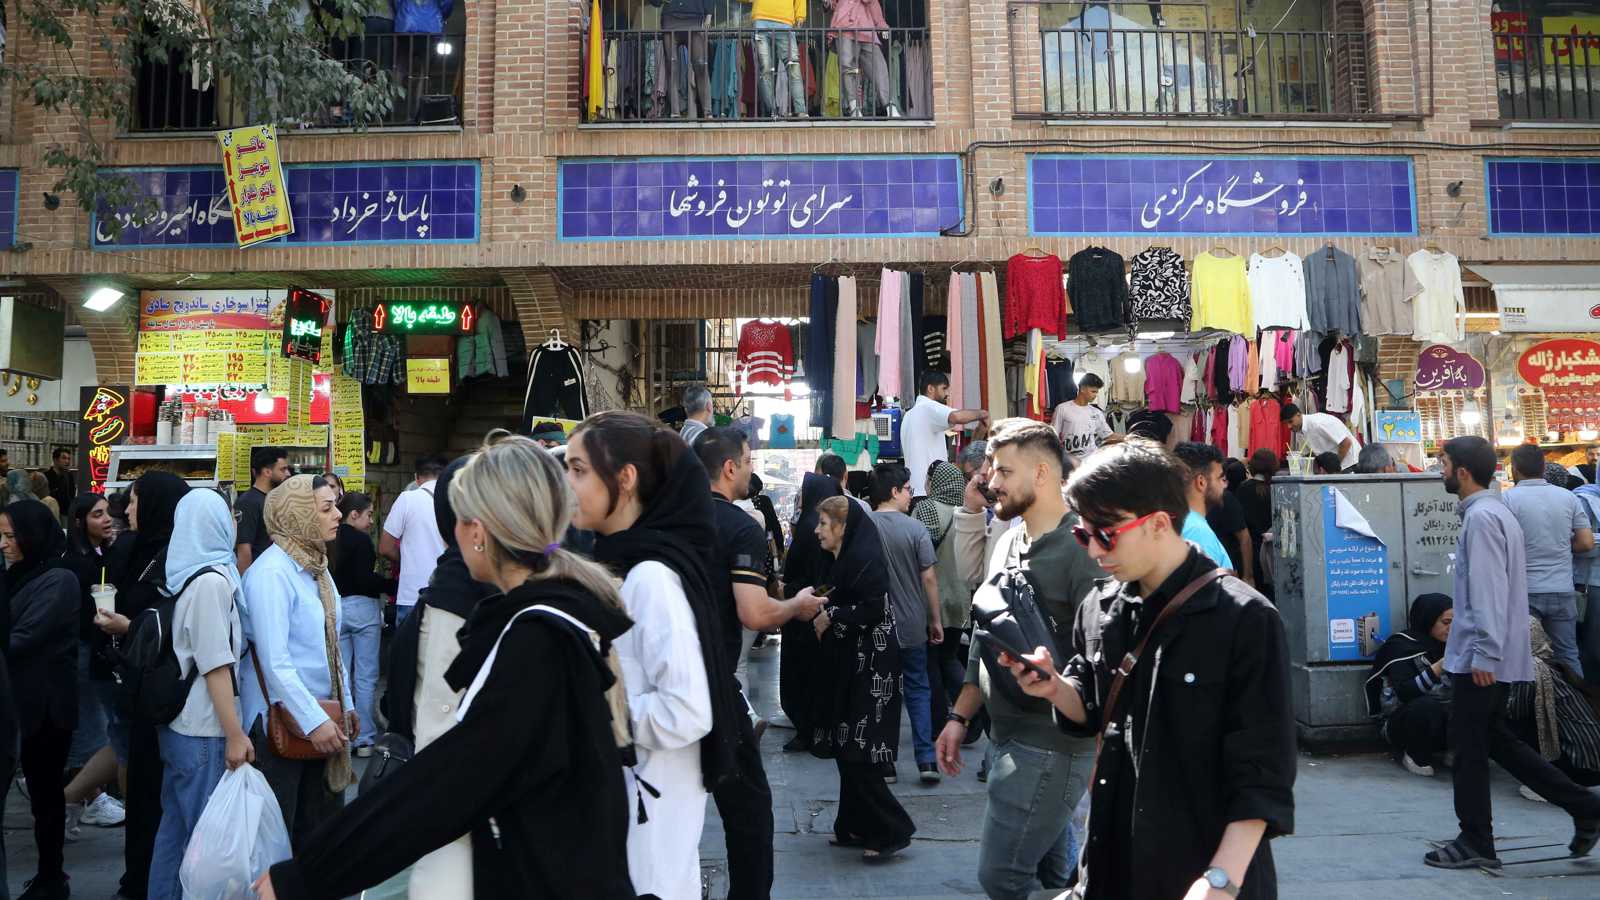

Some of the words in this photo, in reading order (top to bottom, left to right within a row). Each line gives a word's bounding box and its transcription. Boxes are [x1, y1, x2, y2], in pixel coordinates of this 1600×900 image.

[726, 180, 792, 228] توتون
[1141, 161, 1214, 229] مرکزی
[1205, 171, 1308, 216] فروشگاه
[244, 210, 257, 226] بالا
[330, 192, 379, 234] خرداد
[381, 192, 430, 238] پاساژ
[789, 184, 854, 229] سرای
[173, 297, 209, 312] ساندویچ
[211, 296, 250, 312] سوخاری
[391, 304, 417, 328] بالا
[418, 305, 456, 325] طبقه
[1528, 349, 1554, 371] ژاله
[1554, 348, 1600, 371] شکبار
